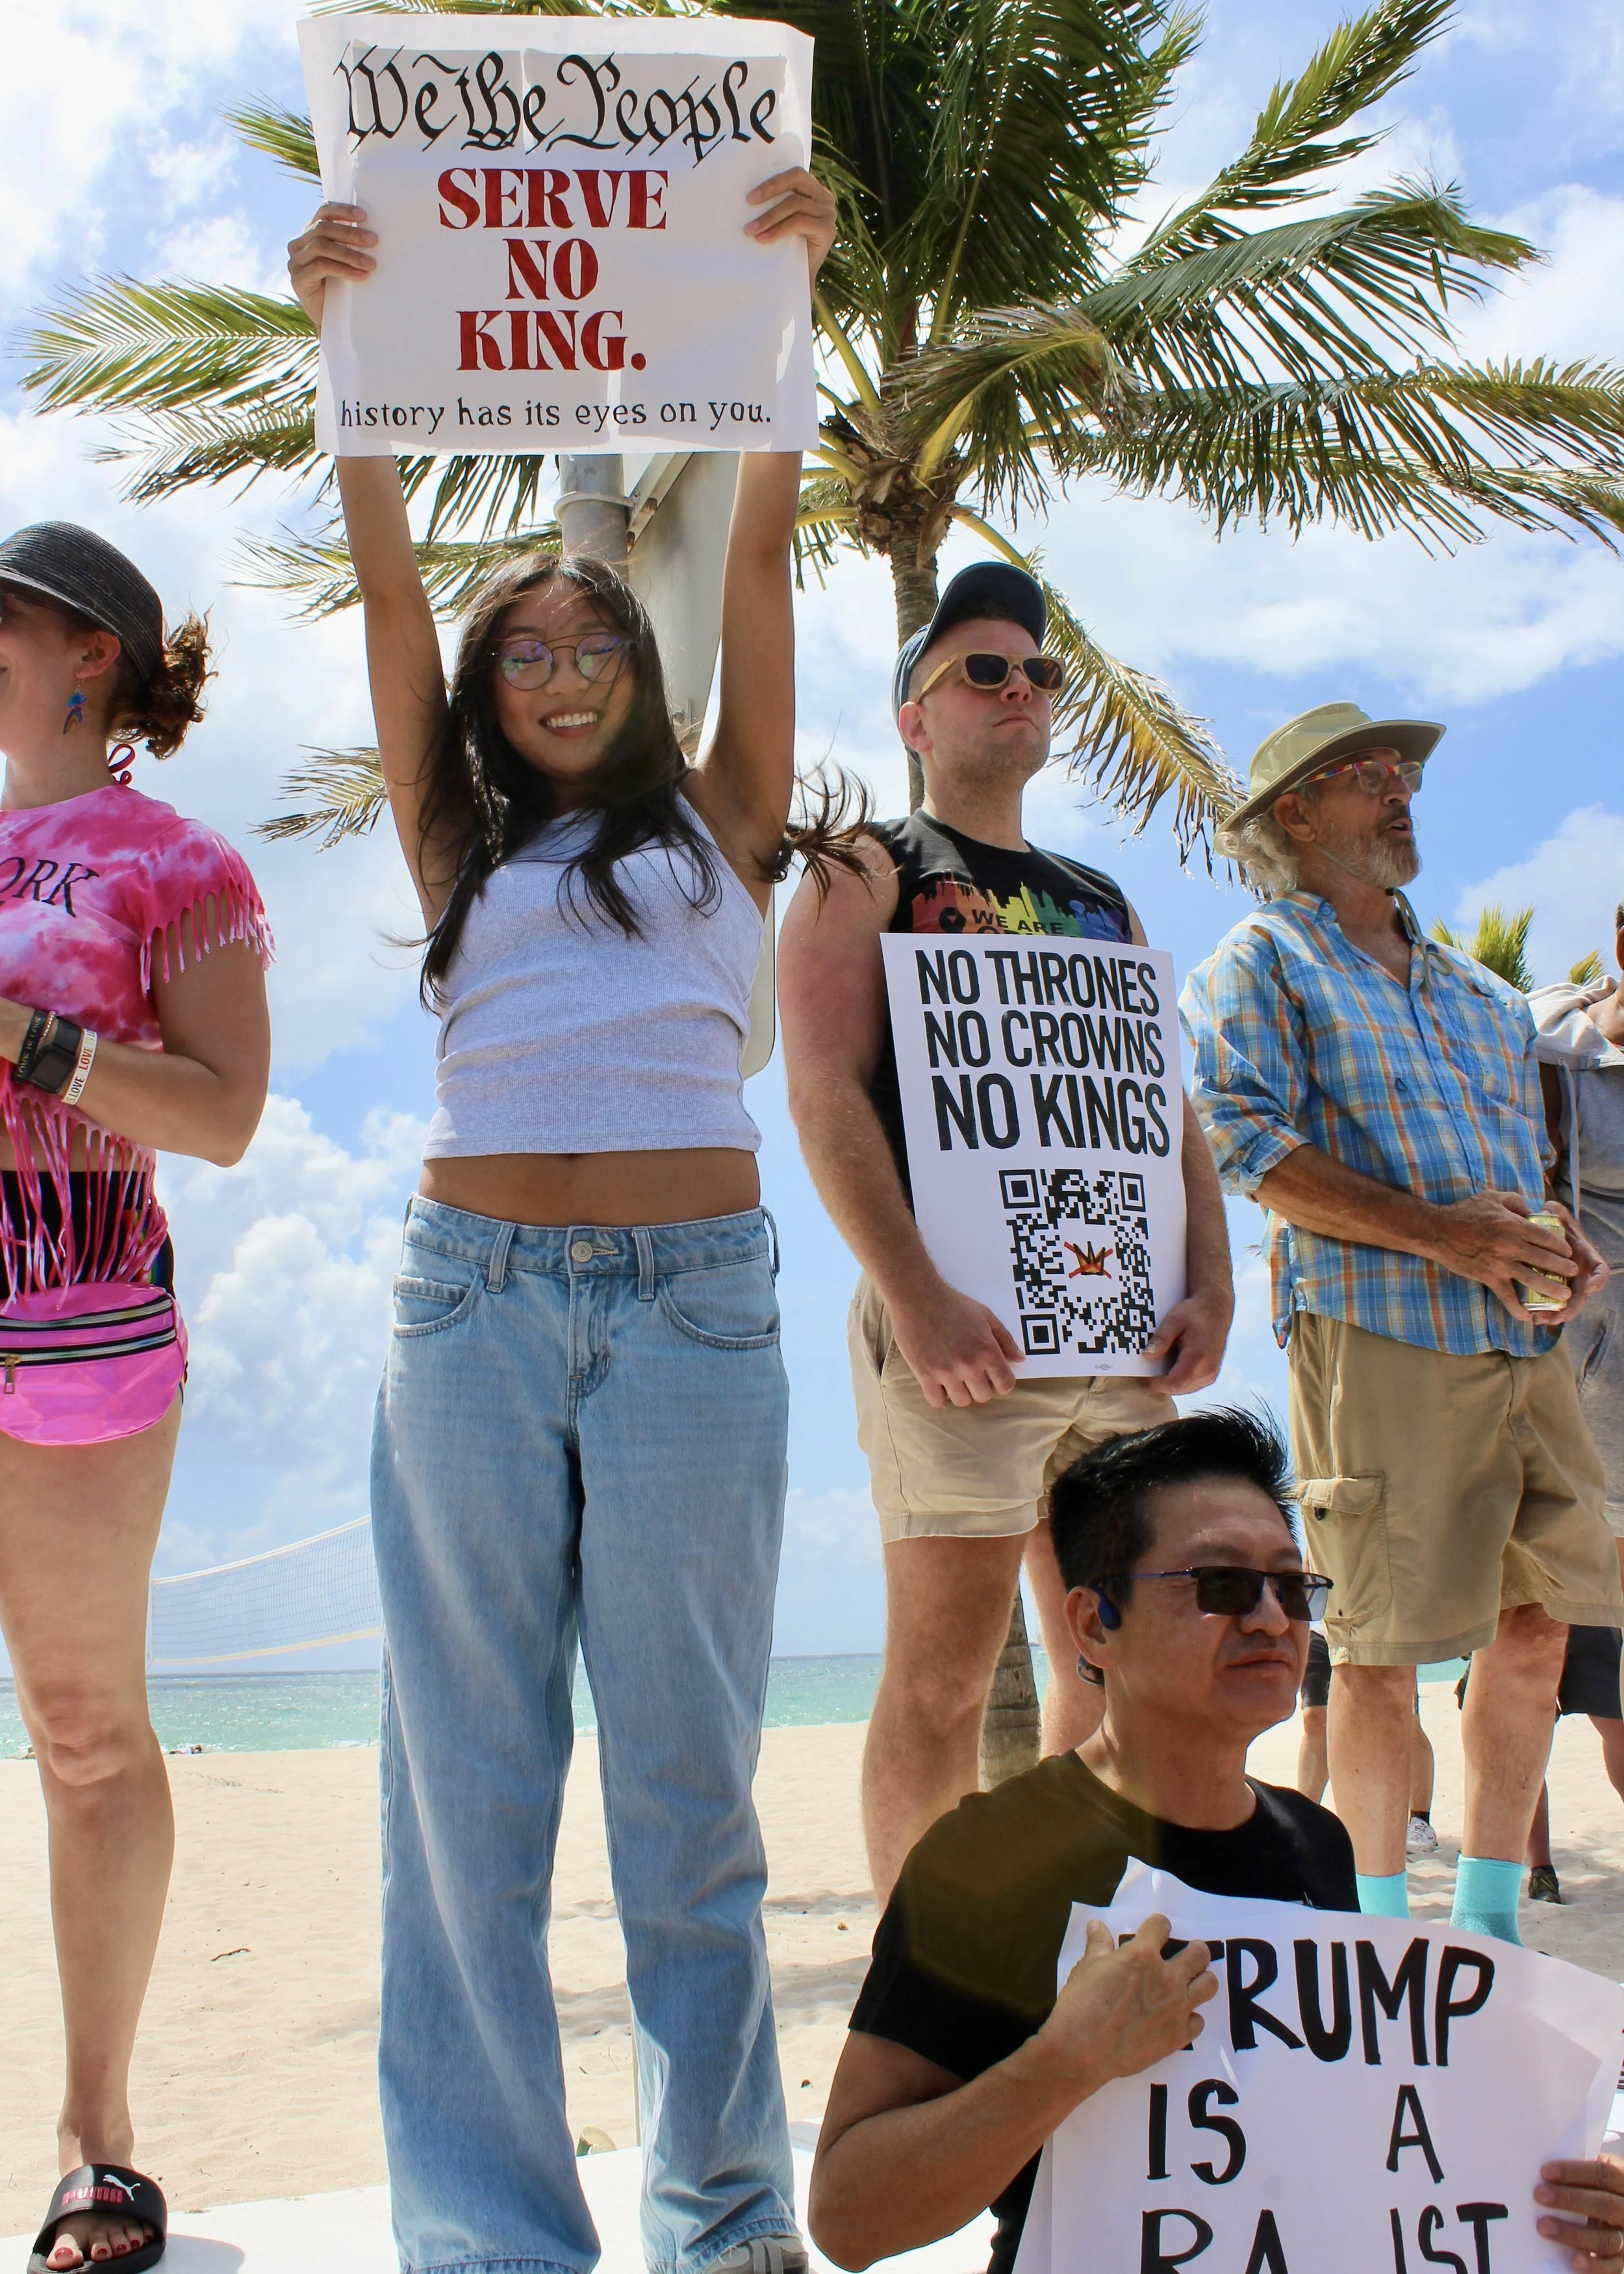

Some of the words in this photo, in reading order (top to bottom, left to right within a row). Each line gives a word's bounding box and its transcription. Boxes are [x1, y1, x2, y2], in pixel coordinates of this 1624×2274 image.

[333, 42, 461, 154] We
[544, 51, 776, 168] People
[438, 168, 668, 230] SERVE
[503, 238, 599, 301] NO
[455, 310, 646, 372] KING.
[340, 399, 445, 435] history
[457, 397, 512, 426] has
[525, 400, 560, 426] its
[576, 403, 647, 433] eyes
[660, 402, 696, 422] on
[708, 402, 771, 431] you.
[972, 909, 1008, 929] WE
[1018, 919, 1065, 936] ARE
[915, 949, 980, 1004] NO
[984, 951, 1160, 1017] THRONES
[69, 1077, 84, 1097] LOVE
[79, 1047, 93, 1070] LOVE
[86, 1036, 95, 1045] IS
[924, 1010, 991, 1068] NO
[1001, 1010, 1165, 1079] CROWNS
[932, 1073, 1021, 1151] NO
[1030, 1074, 1171, 1157] KINGS
[1147, 2079, 1247, 2186] IS
[1386, 2084, 1445, 2185] A
[61, 2186, 123, 2206] PUMA
